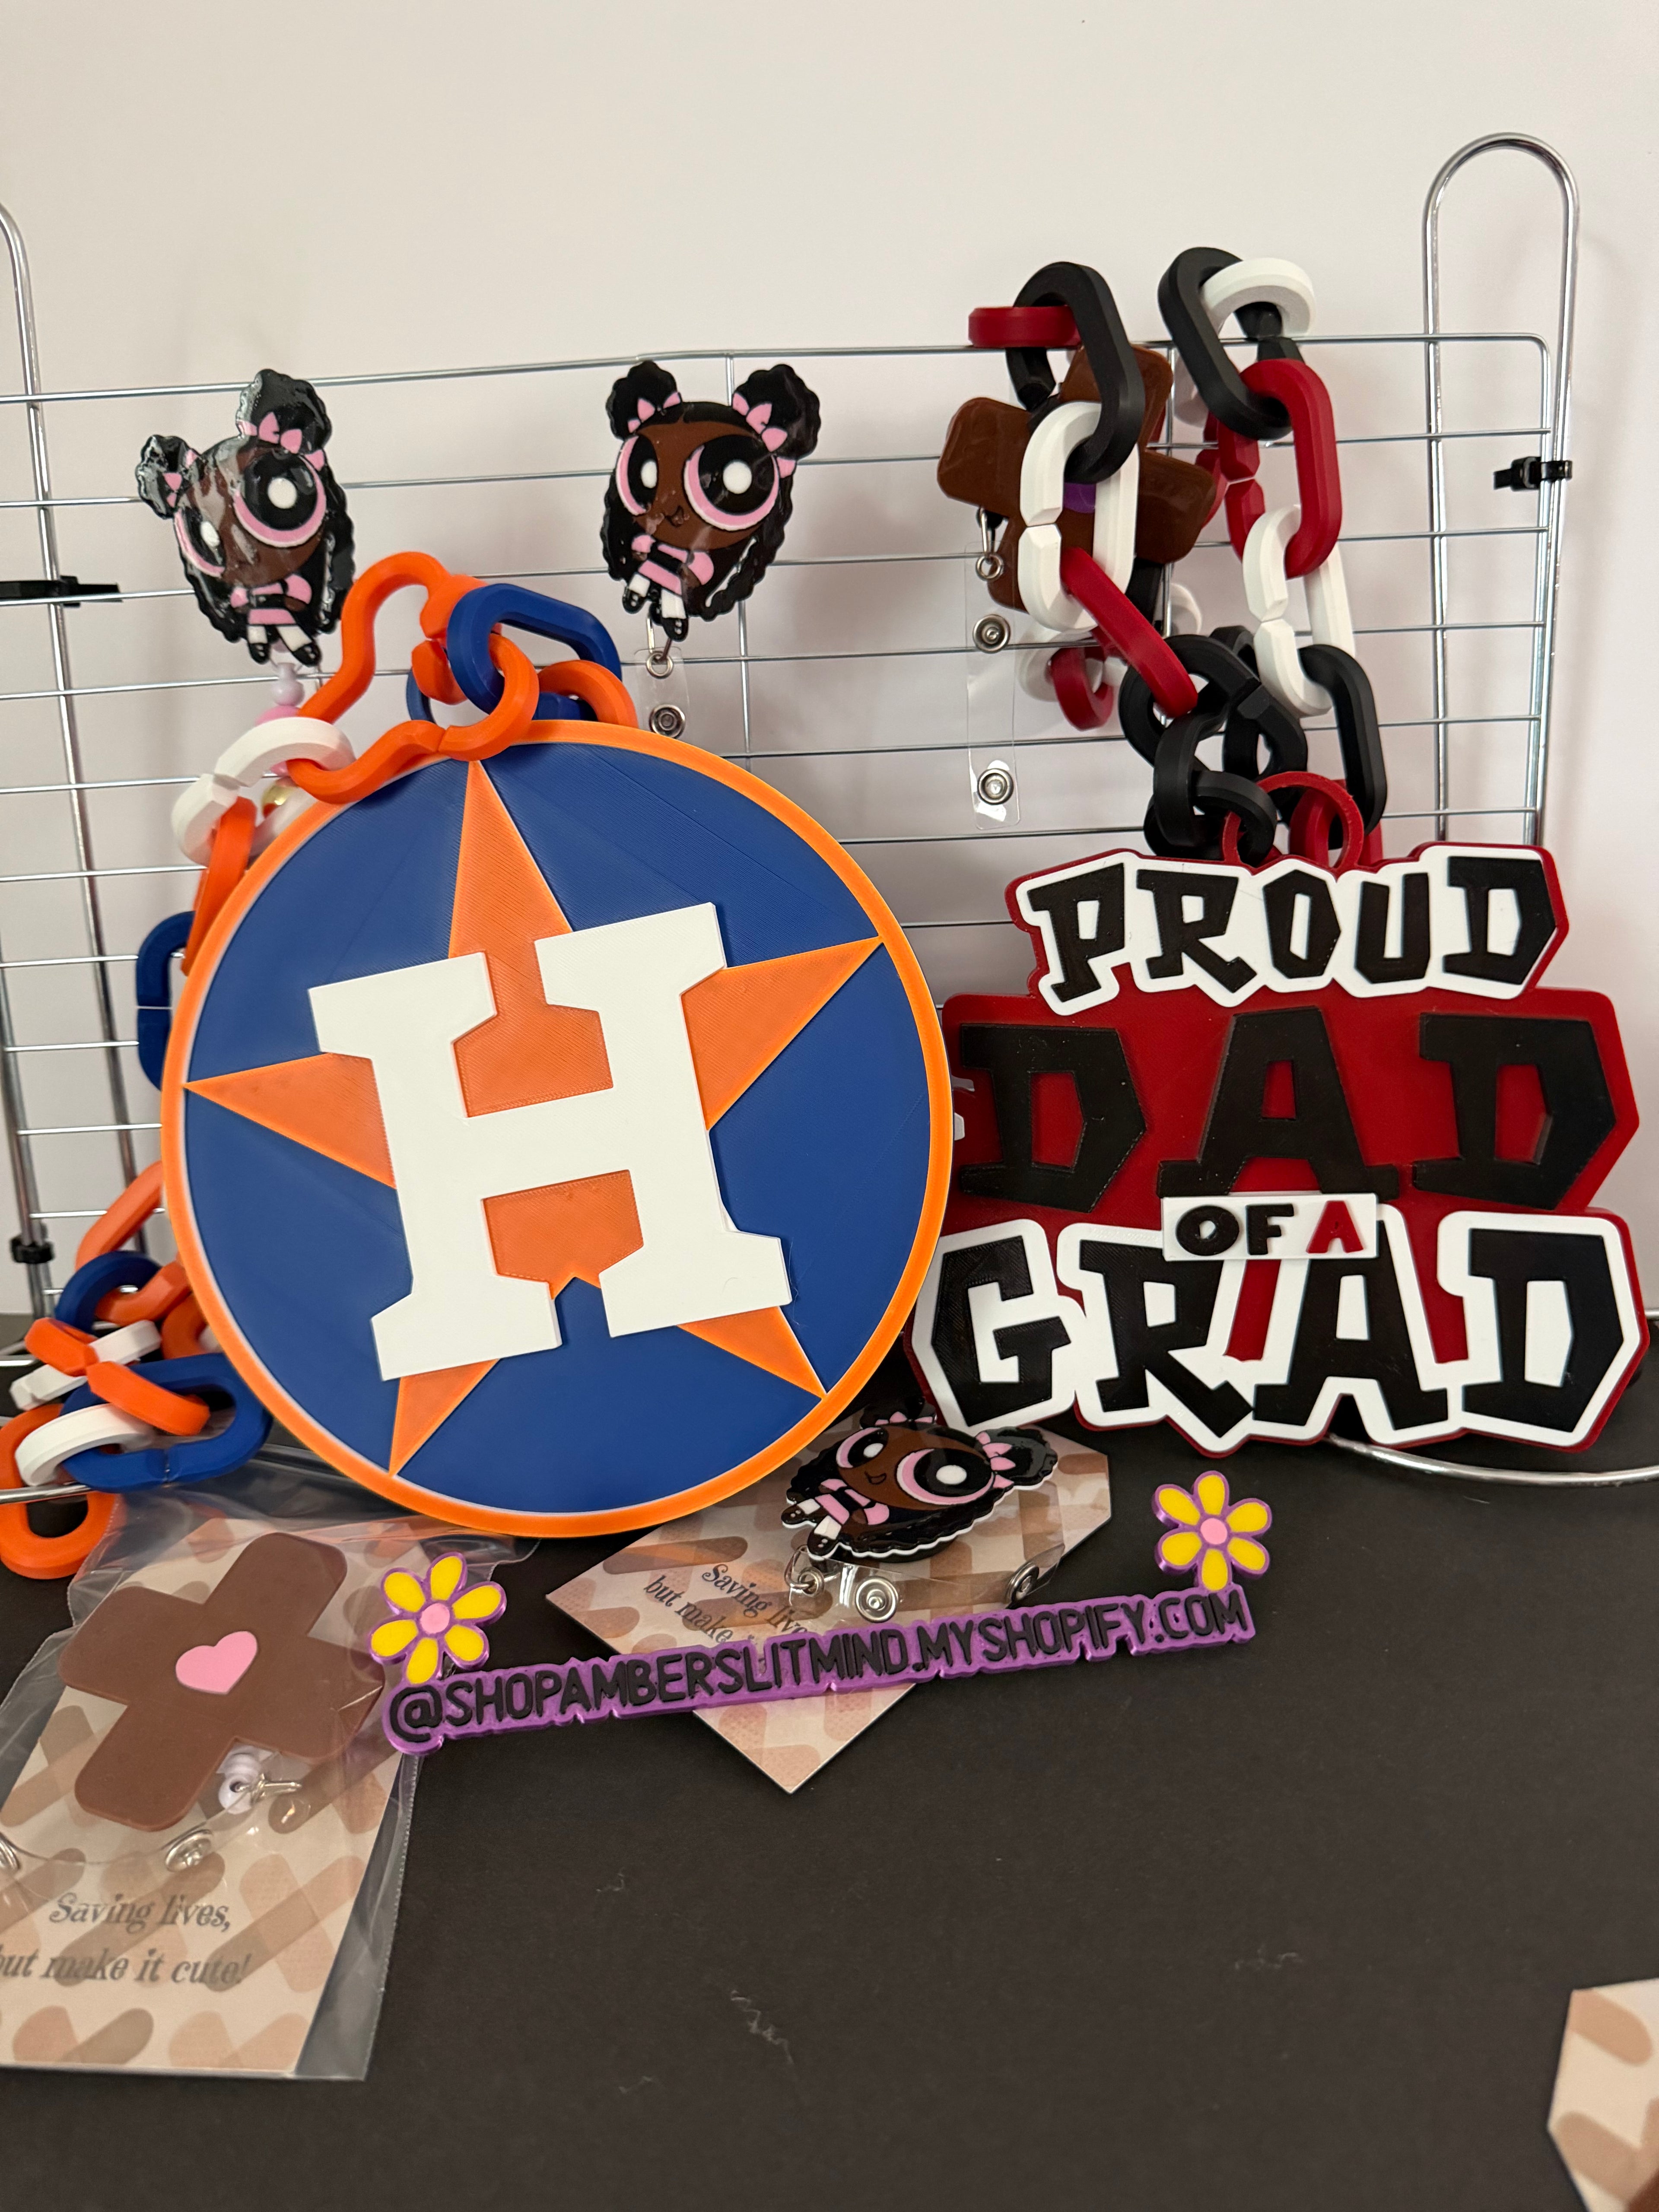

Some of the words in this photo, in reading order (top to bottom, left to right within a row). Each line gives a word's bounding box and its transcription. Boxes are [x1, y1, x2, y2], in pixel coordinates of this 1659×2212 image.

[1028, 856, 1558, 1002] PROUD
[308, 902, 792, 1381] H
[960, 1007, 1617, 1212] DAD
[1176, 1204, 1294, 1256] OF
[1306, 1200, 1364, 1253] A
[932, 1220, 1624, 1437] GRAD
[644, 1575, 684, 1607] but
[675, 1601, 733, 1642] make
[702, 1564, 772, 1618] Saving
[390, 1589, 1247, 1742] @SHOPAMBERSLITMIND.MYSHOPIFY.COM
[40, 1948, 129, 1980] make
[134, 1948, 165, 1982] it
[171, 1953, 252, 1984] cute!
[49, 1892, 155, 1934] Saving
[160, 1894, 230, 1932] lives,
